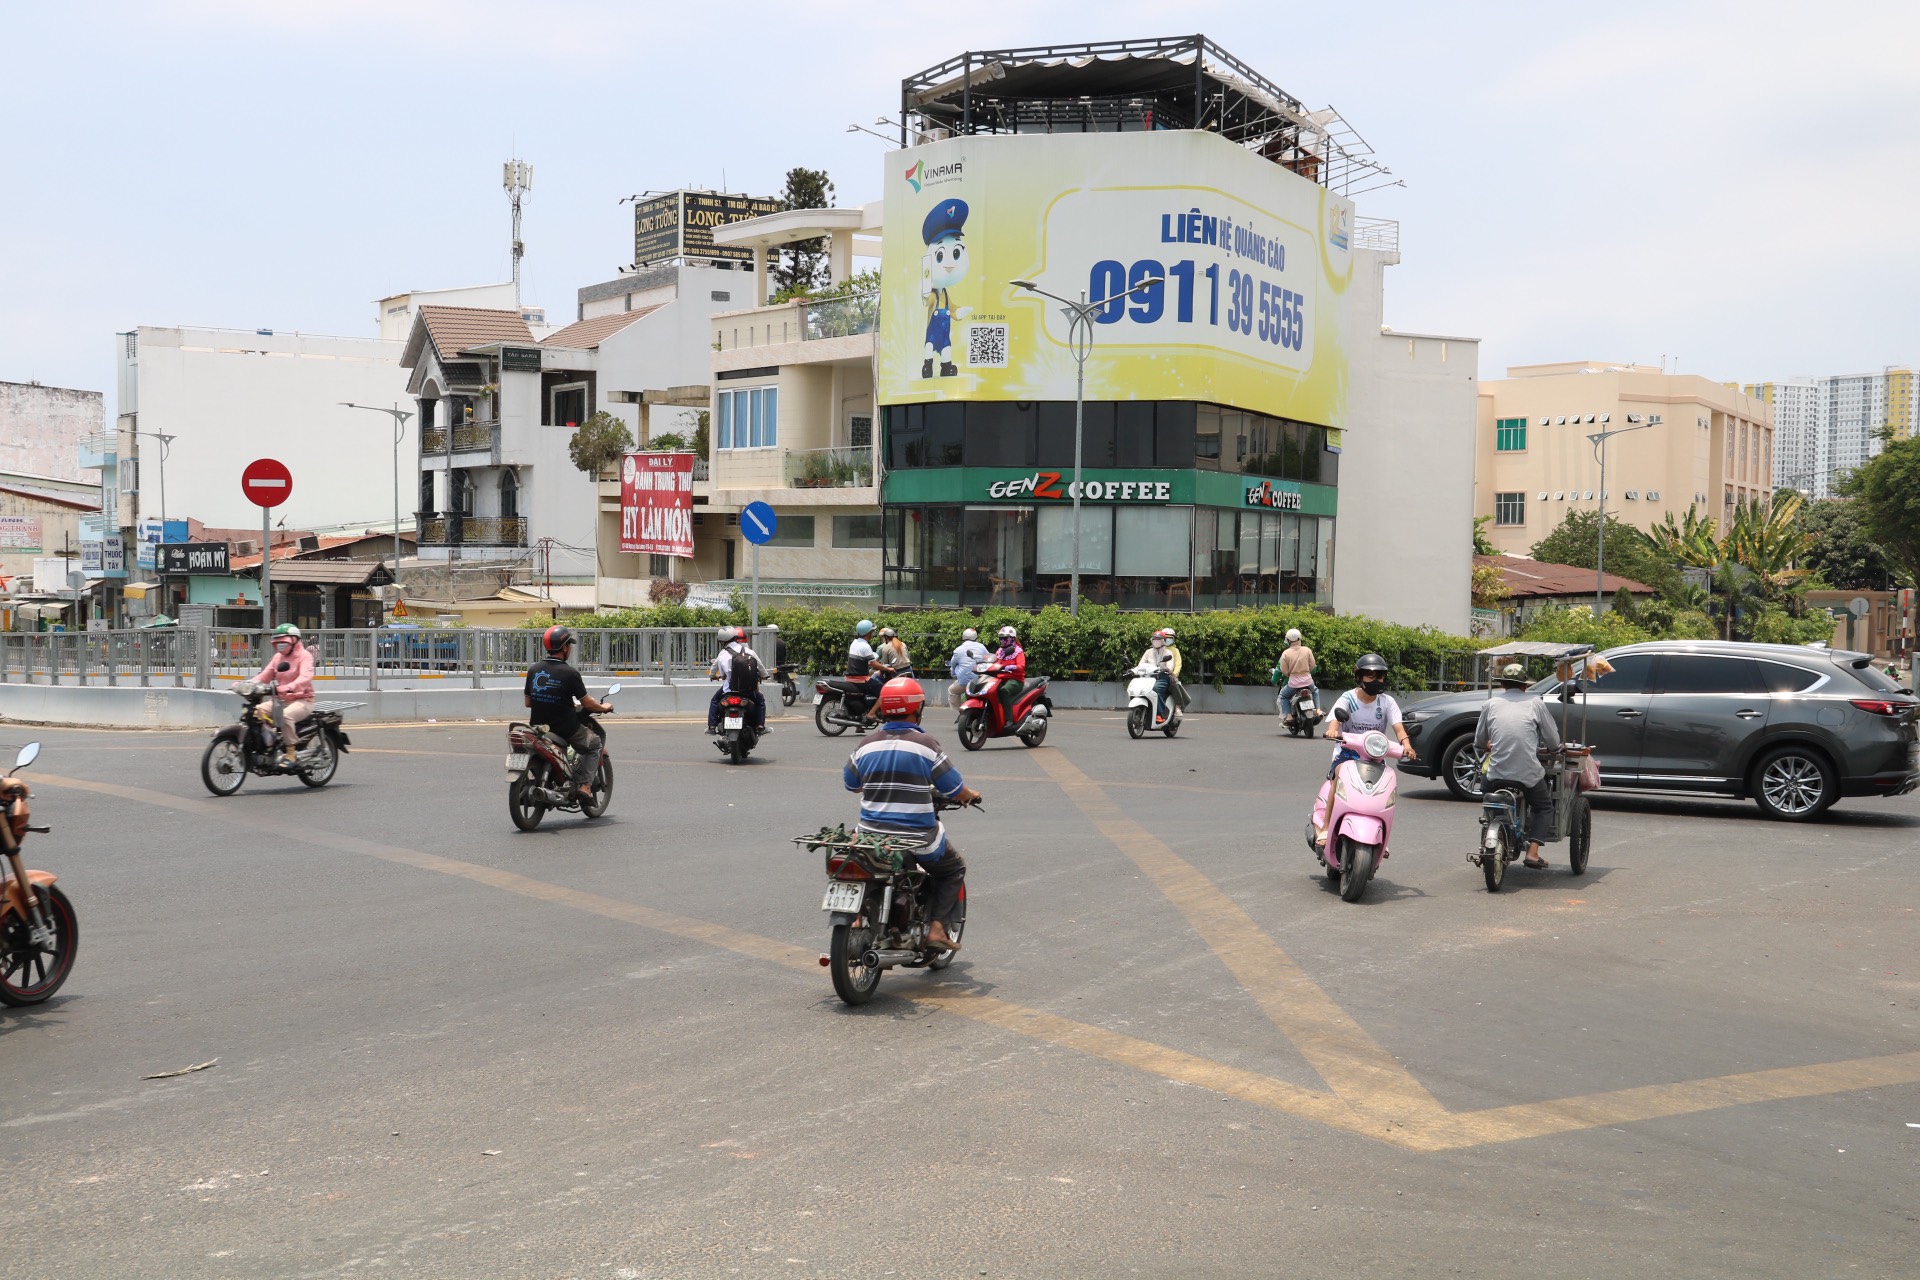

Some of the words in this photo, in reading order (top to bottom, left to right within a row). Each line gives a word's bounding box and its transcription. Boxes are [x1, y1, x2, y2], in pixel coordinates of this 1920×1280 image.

[924, 163, 963, 180] VINAMA
[698, 197, 714, 207] TNHH
[759, 203, 771, 212] BAO
[637, 217, 654, 235] LONG
[686, 209, 725, 227] LONG
[1161, 208, 1217, 245] LIÊN
[1219, 215, 1232, 257] HỆ
[1234, 220, 1265, 263] QUẢNG
[1267, 234, 1286, 273] CÁO
[1227, 268, 1254, 336] 39
[1258, 280, 1304, 352] 5555
[663, 456, 673, 466] LÝ
[634, 468, 653, 491] BÁNH
[654, 471, 675, 492] TRUNG
[1068, 481, 1171, 500] COFFEE
[1272, 490, 1302, 510] COFFEE
[641, 496, 662, 541] LÂM
[663, 497, 692, 543] MÔN
[104, 548, 123, 558] THUỐC
[189, 547, 212, 569] HOÀN
[108, 560, 119, 570] TÂY
